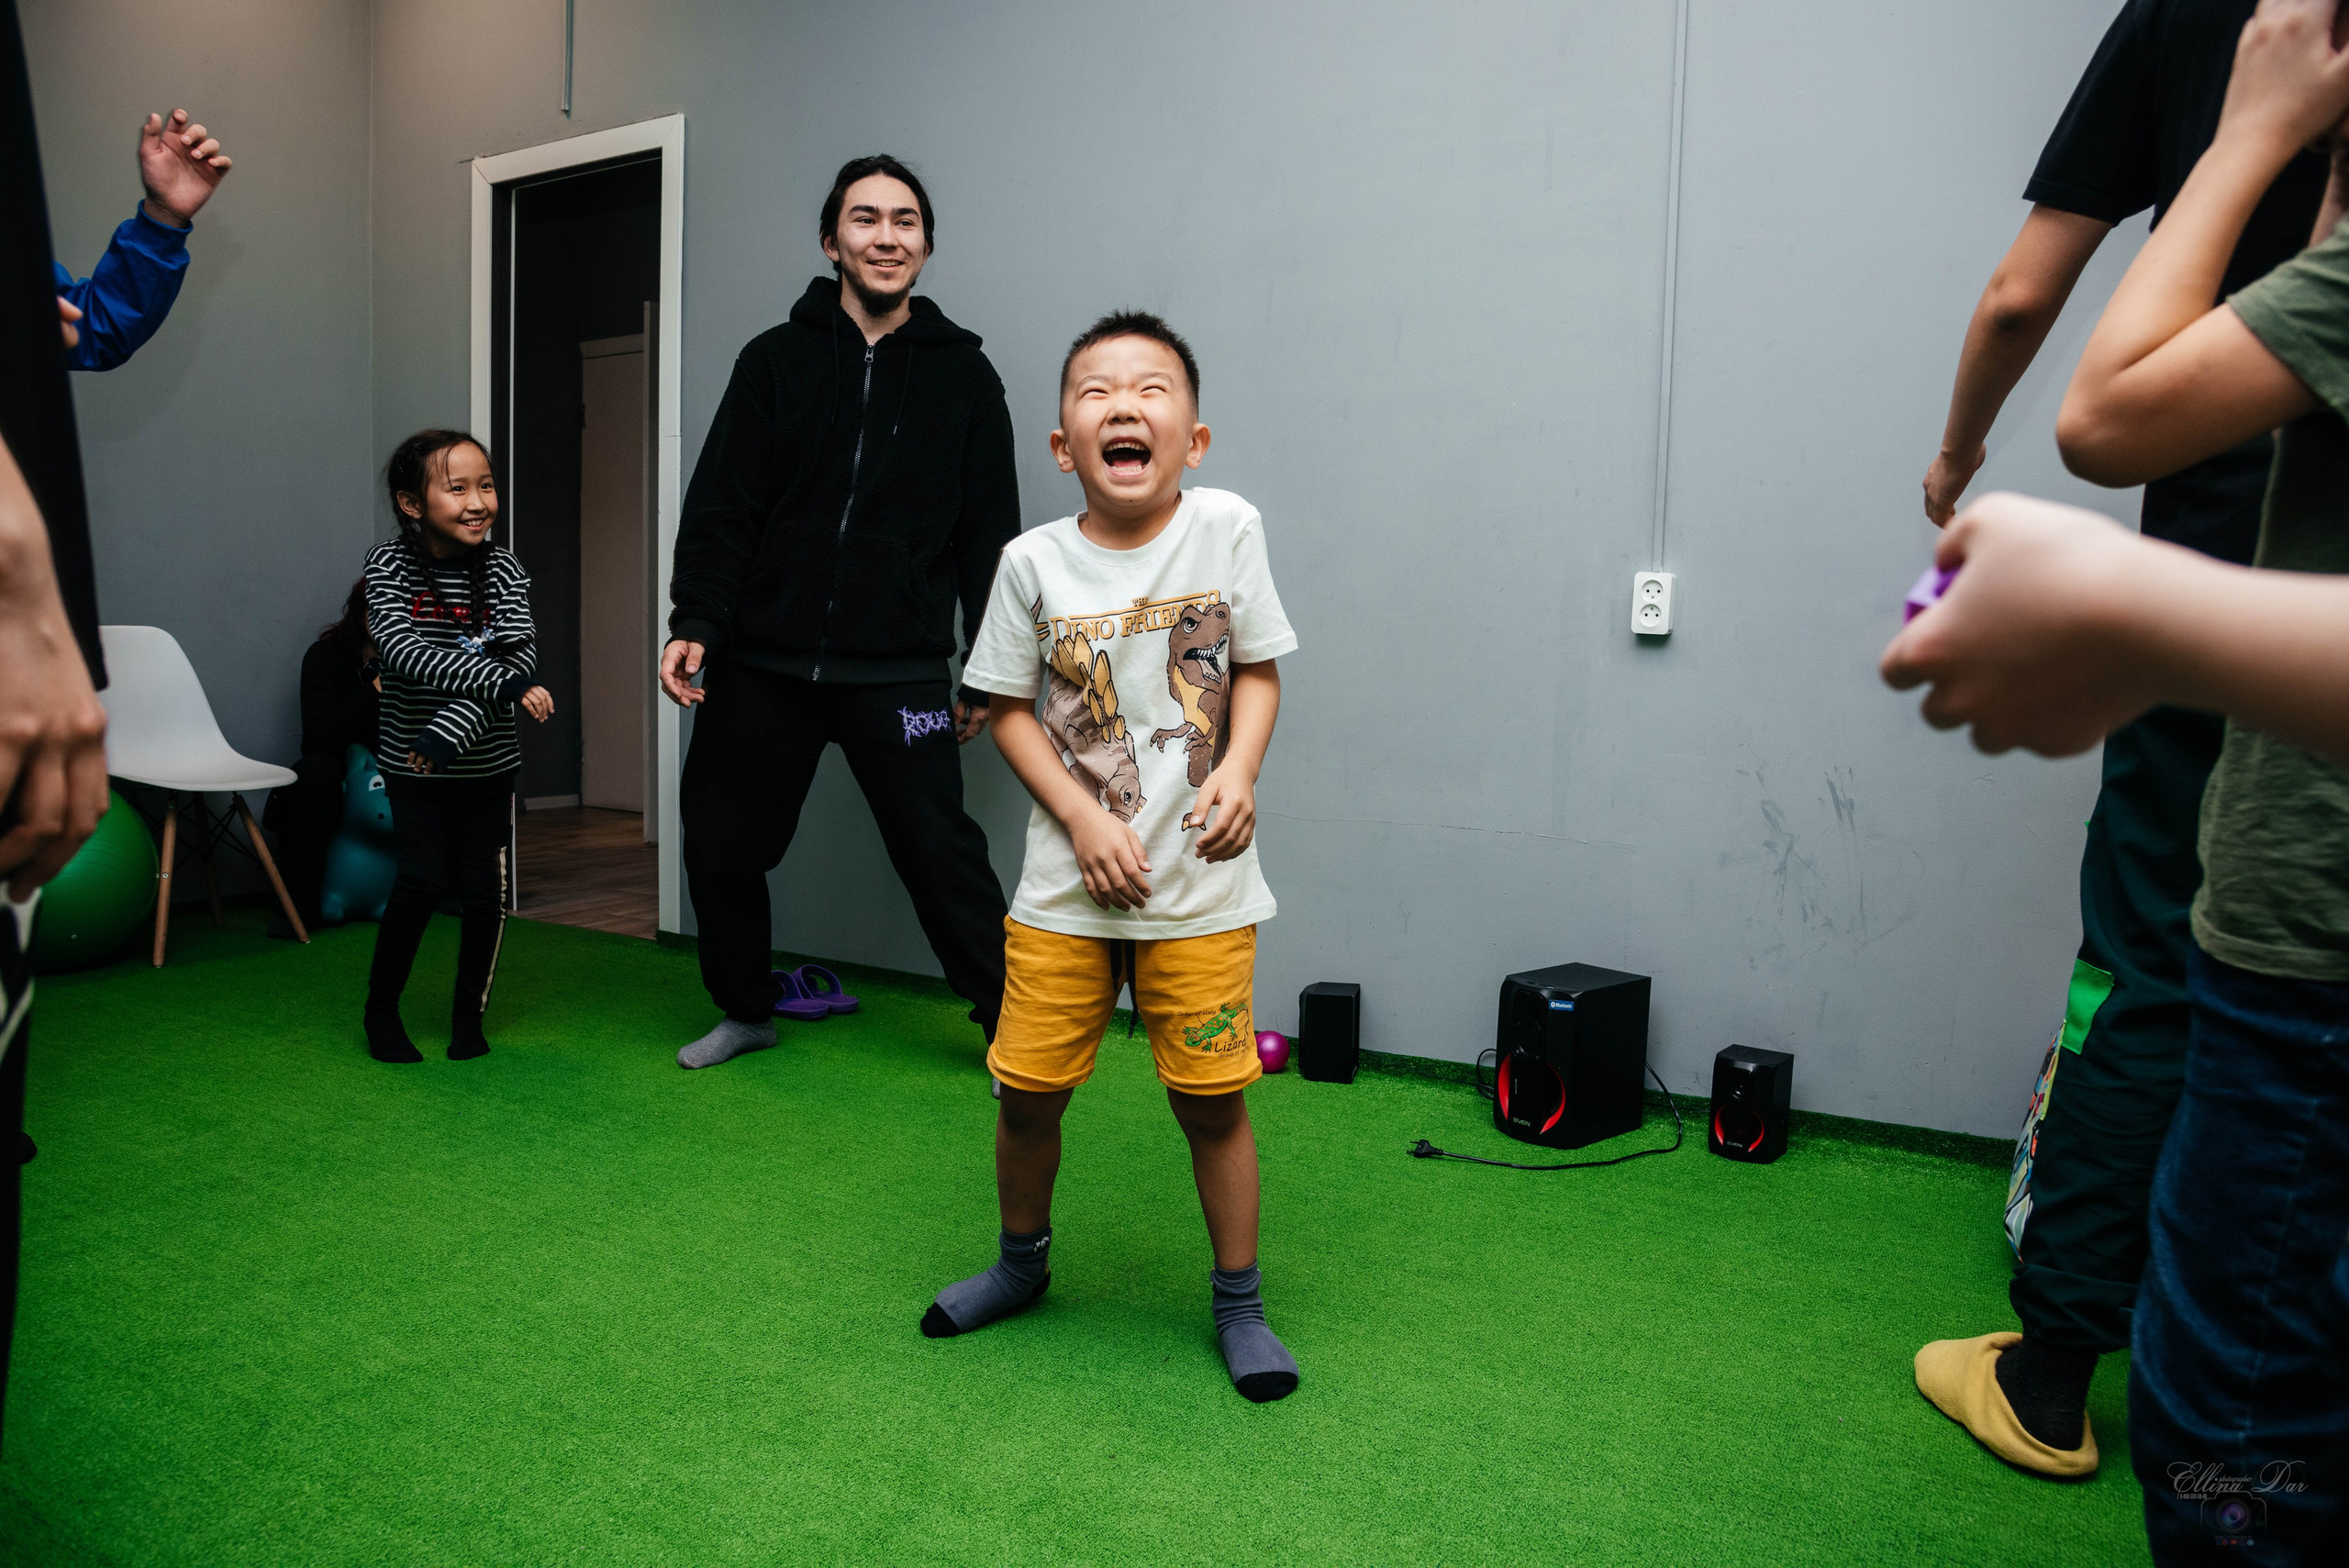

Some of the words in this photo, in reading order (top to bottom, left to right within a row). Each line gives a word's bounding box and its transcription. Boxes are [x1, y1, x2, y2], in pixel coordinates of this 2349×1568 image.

[1131, 596, 1149, 607] THE
[1050, 617, 1116, 645] DINO
[1214, 1033, 1247, 1053] Lizard
[1512, 1117, 1531, 1127] SVEN
